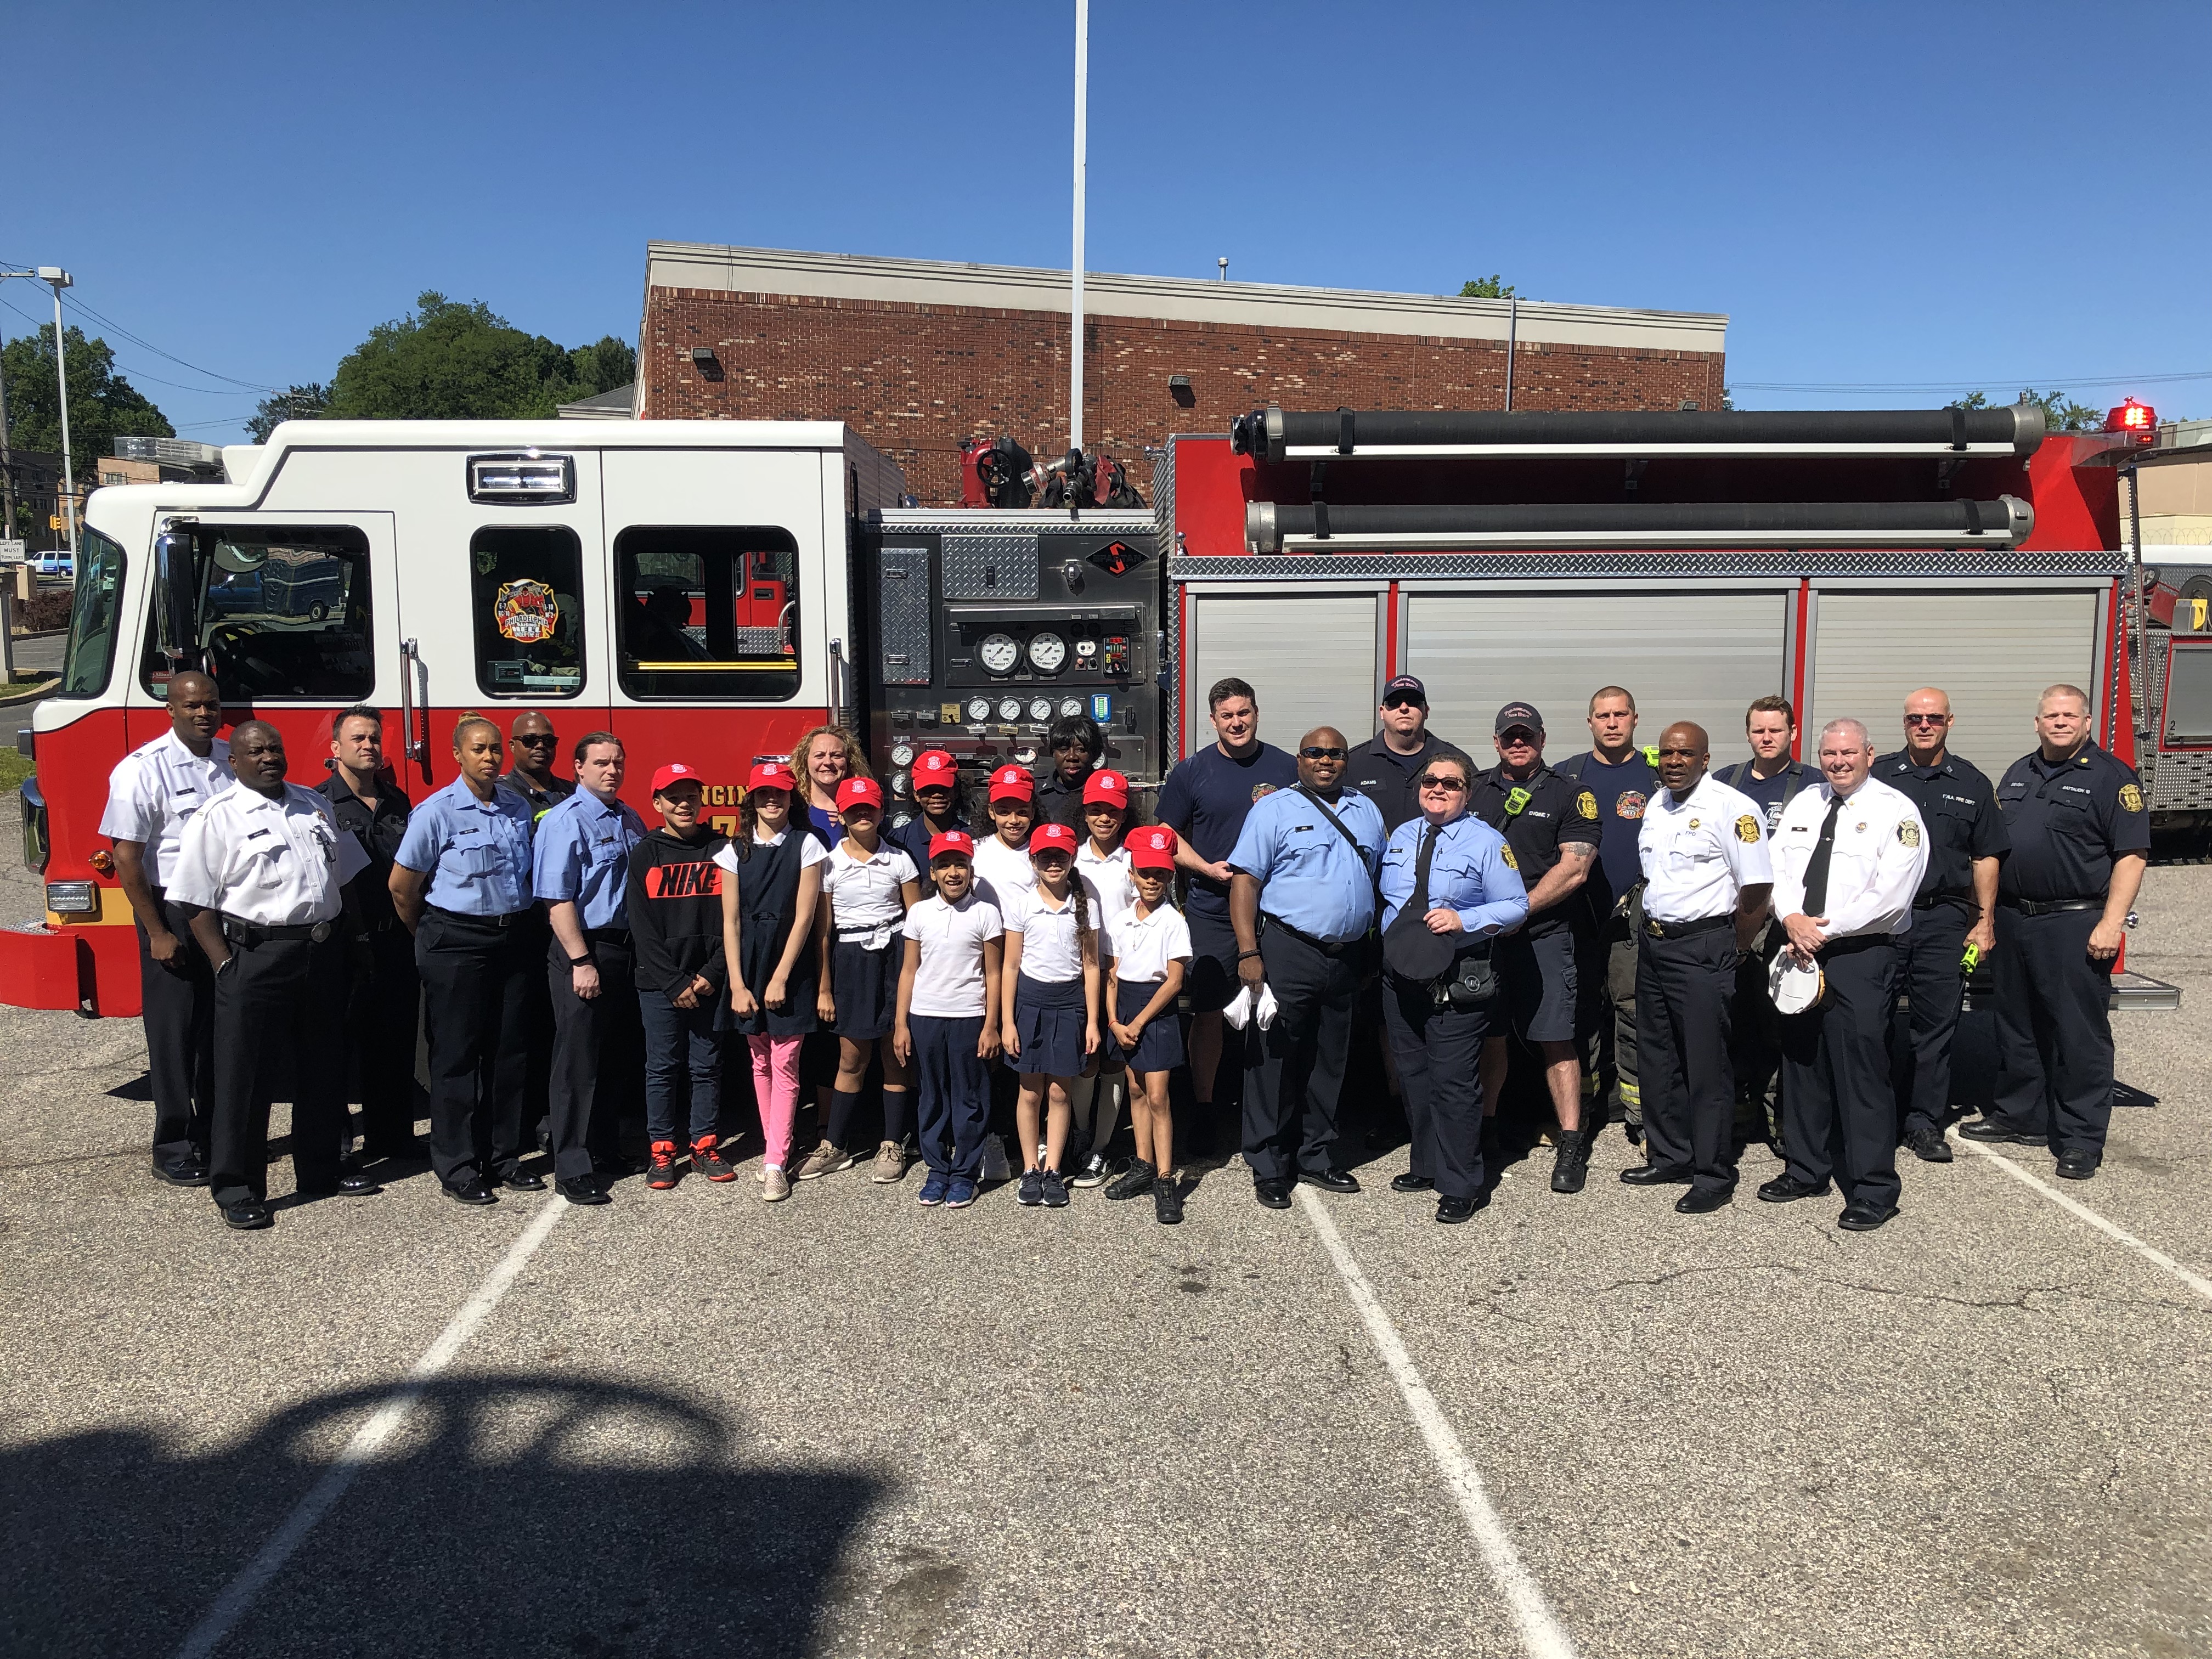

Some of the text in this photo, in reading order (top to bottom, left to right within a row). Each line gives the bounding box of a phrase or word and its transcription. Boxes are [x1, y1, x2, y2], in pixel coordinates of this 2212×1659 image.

[505, 615, 549, 626] PHILADELPHIA
[2170, 720, 2176, 731] 2
[701, 786, 749, 805] NGIN
[713, 815, 737, 838] 7
[657, 862, 718, 896] NIKE
